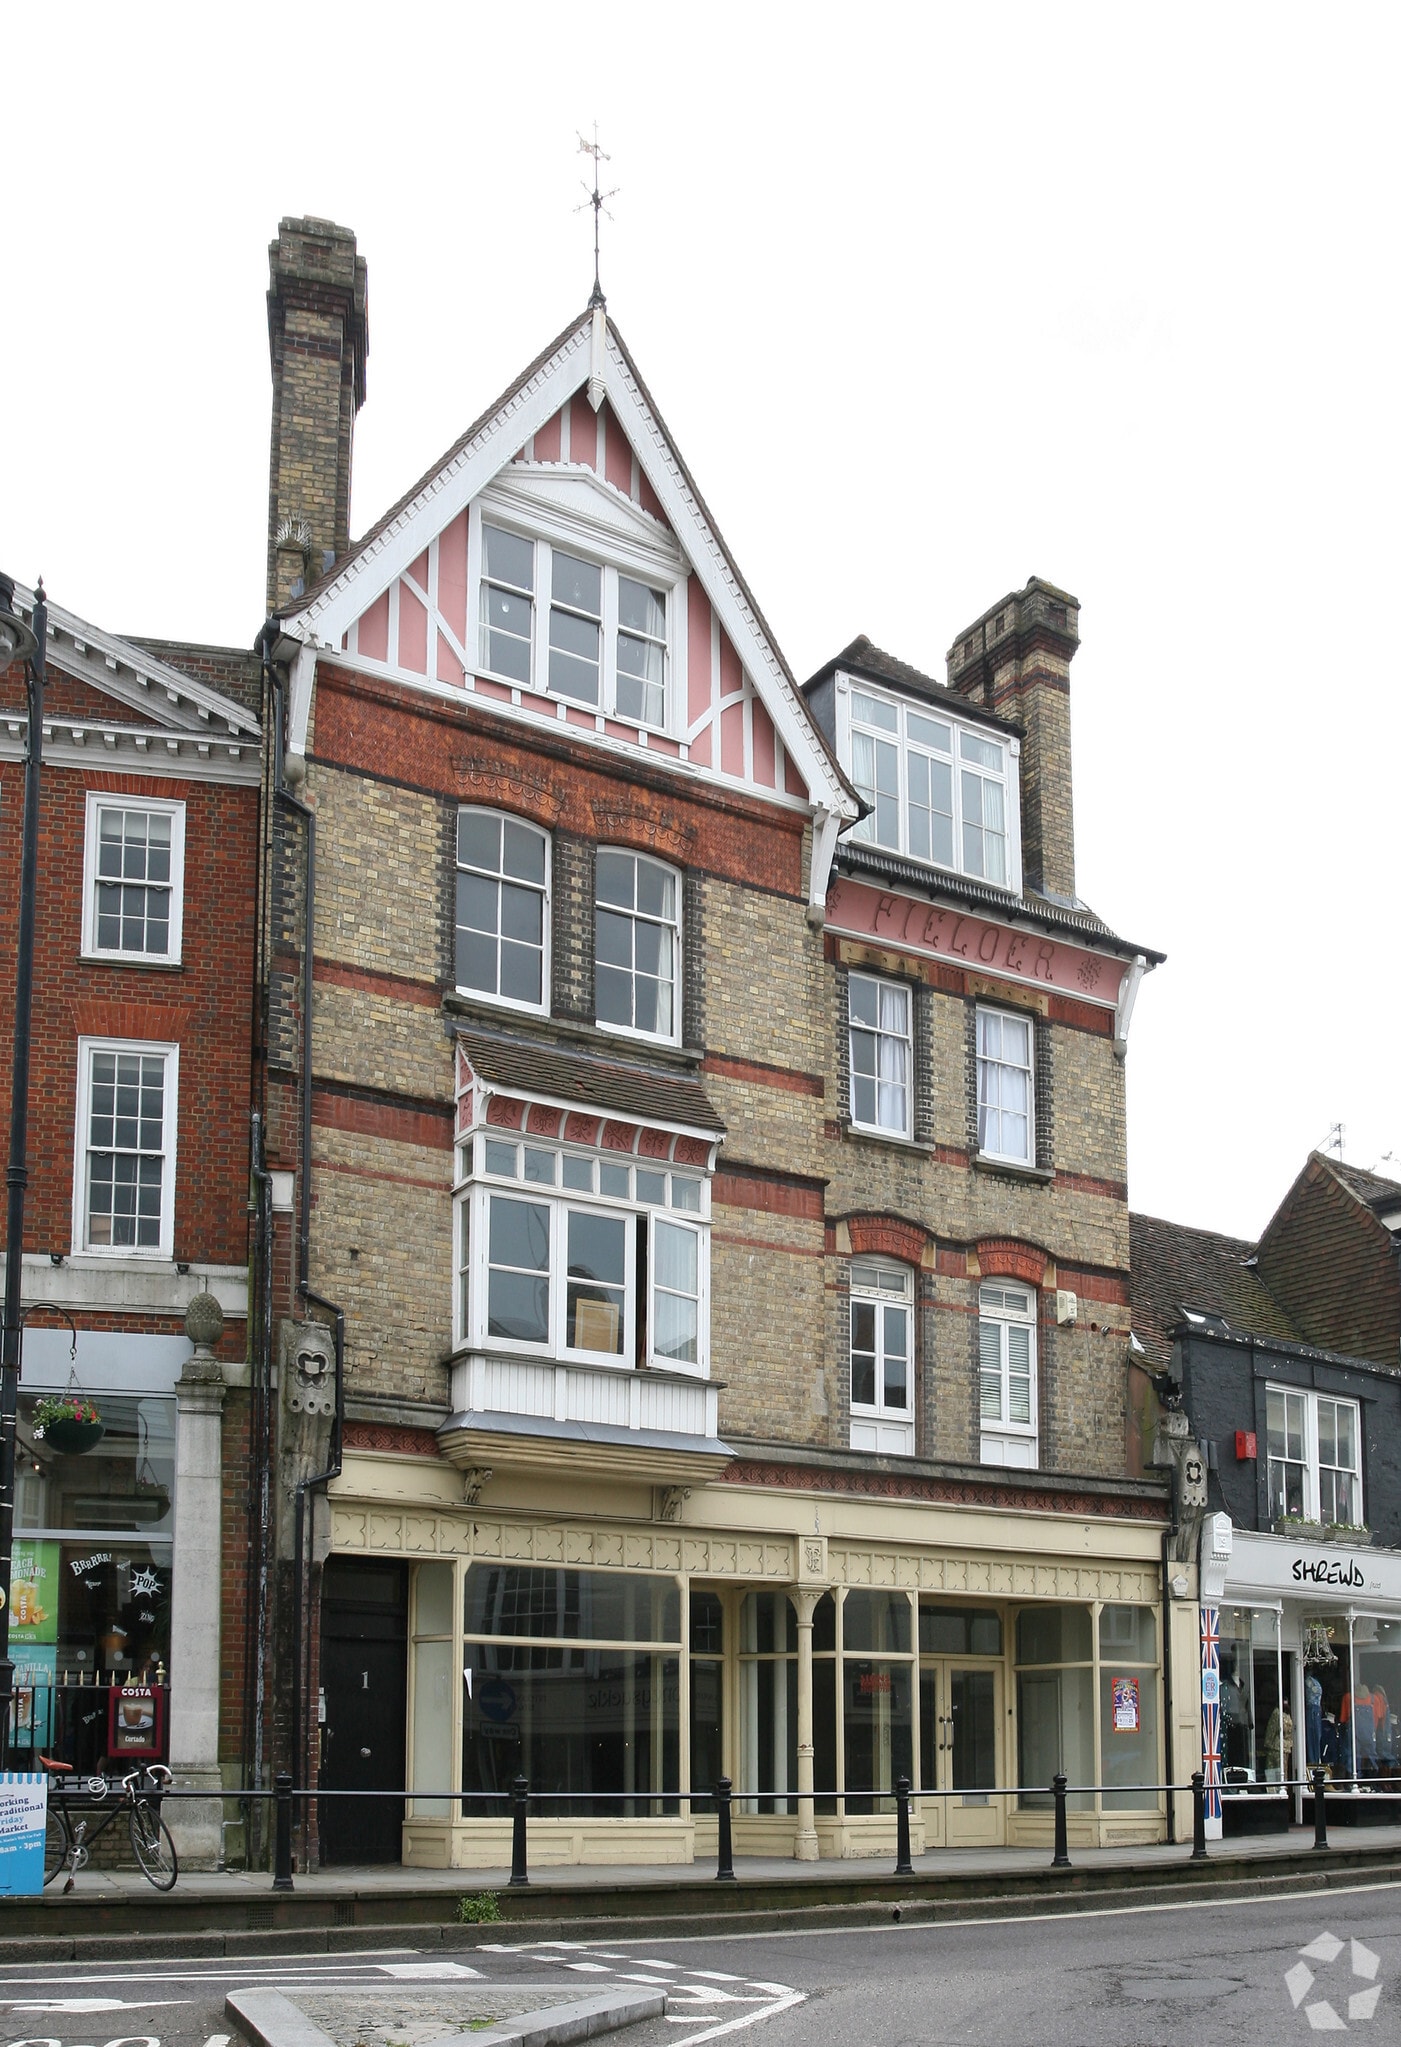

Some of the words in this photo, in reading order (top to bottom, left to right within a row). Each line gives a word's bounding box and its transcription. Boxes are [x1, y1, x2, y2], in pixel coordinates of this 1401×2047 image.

[11, 1558, 33, 1570] EACH
[11, 1566, 46, 1579] MONADE
[1292, 1559, 1364, 1588] SHREWD
[137, 1576, 156, 1589] POP
[15, 1663, 48, 1674] VANILLA
[361, 1671, 370, 1689] 1
[121, 1688, 151, 1697] COSTA
[124, 1735, 145, 1743] Cortado
[0, 1798, 29, 1807] orking
[0, 1803, 43, 1816] raditional
[0, 1816, 24, 1825] riday
